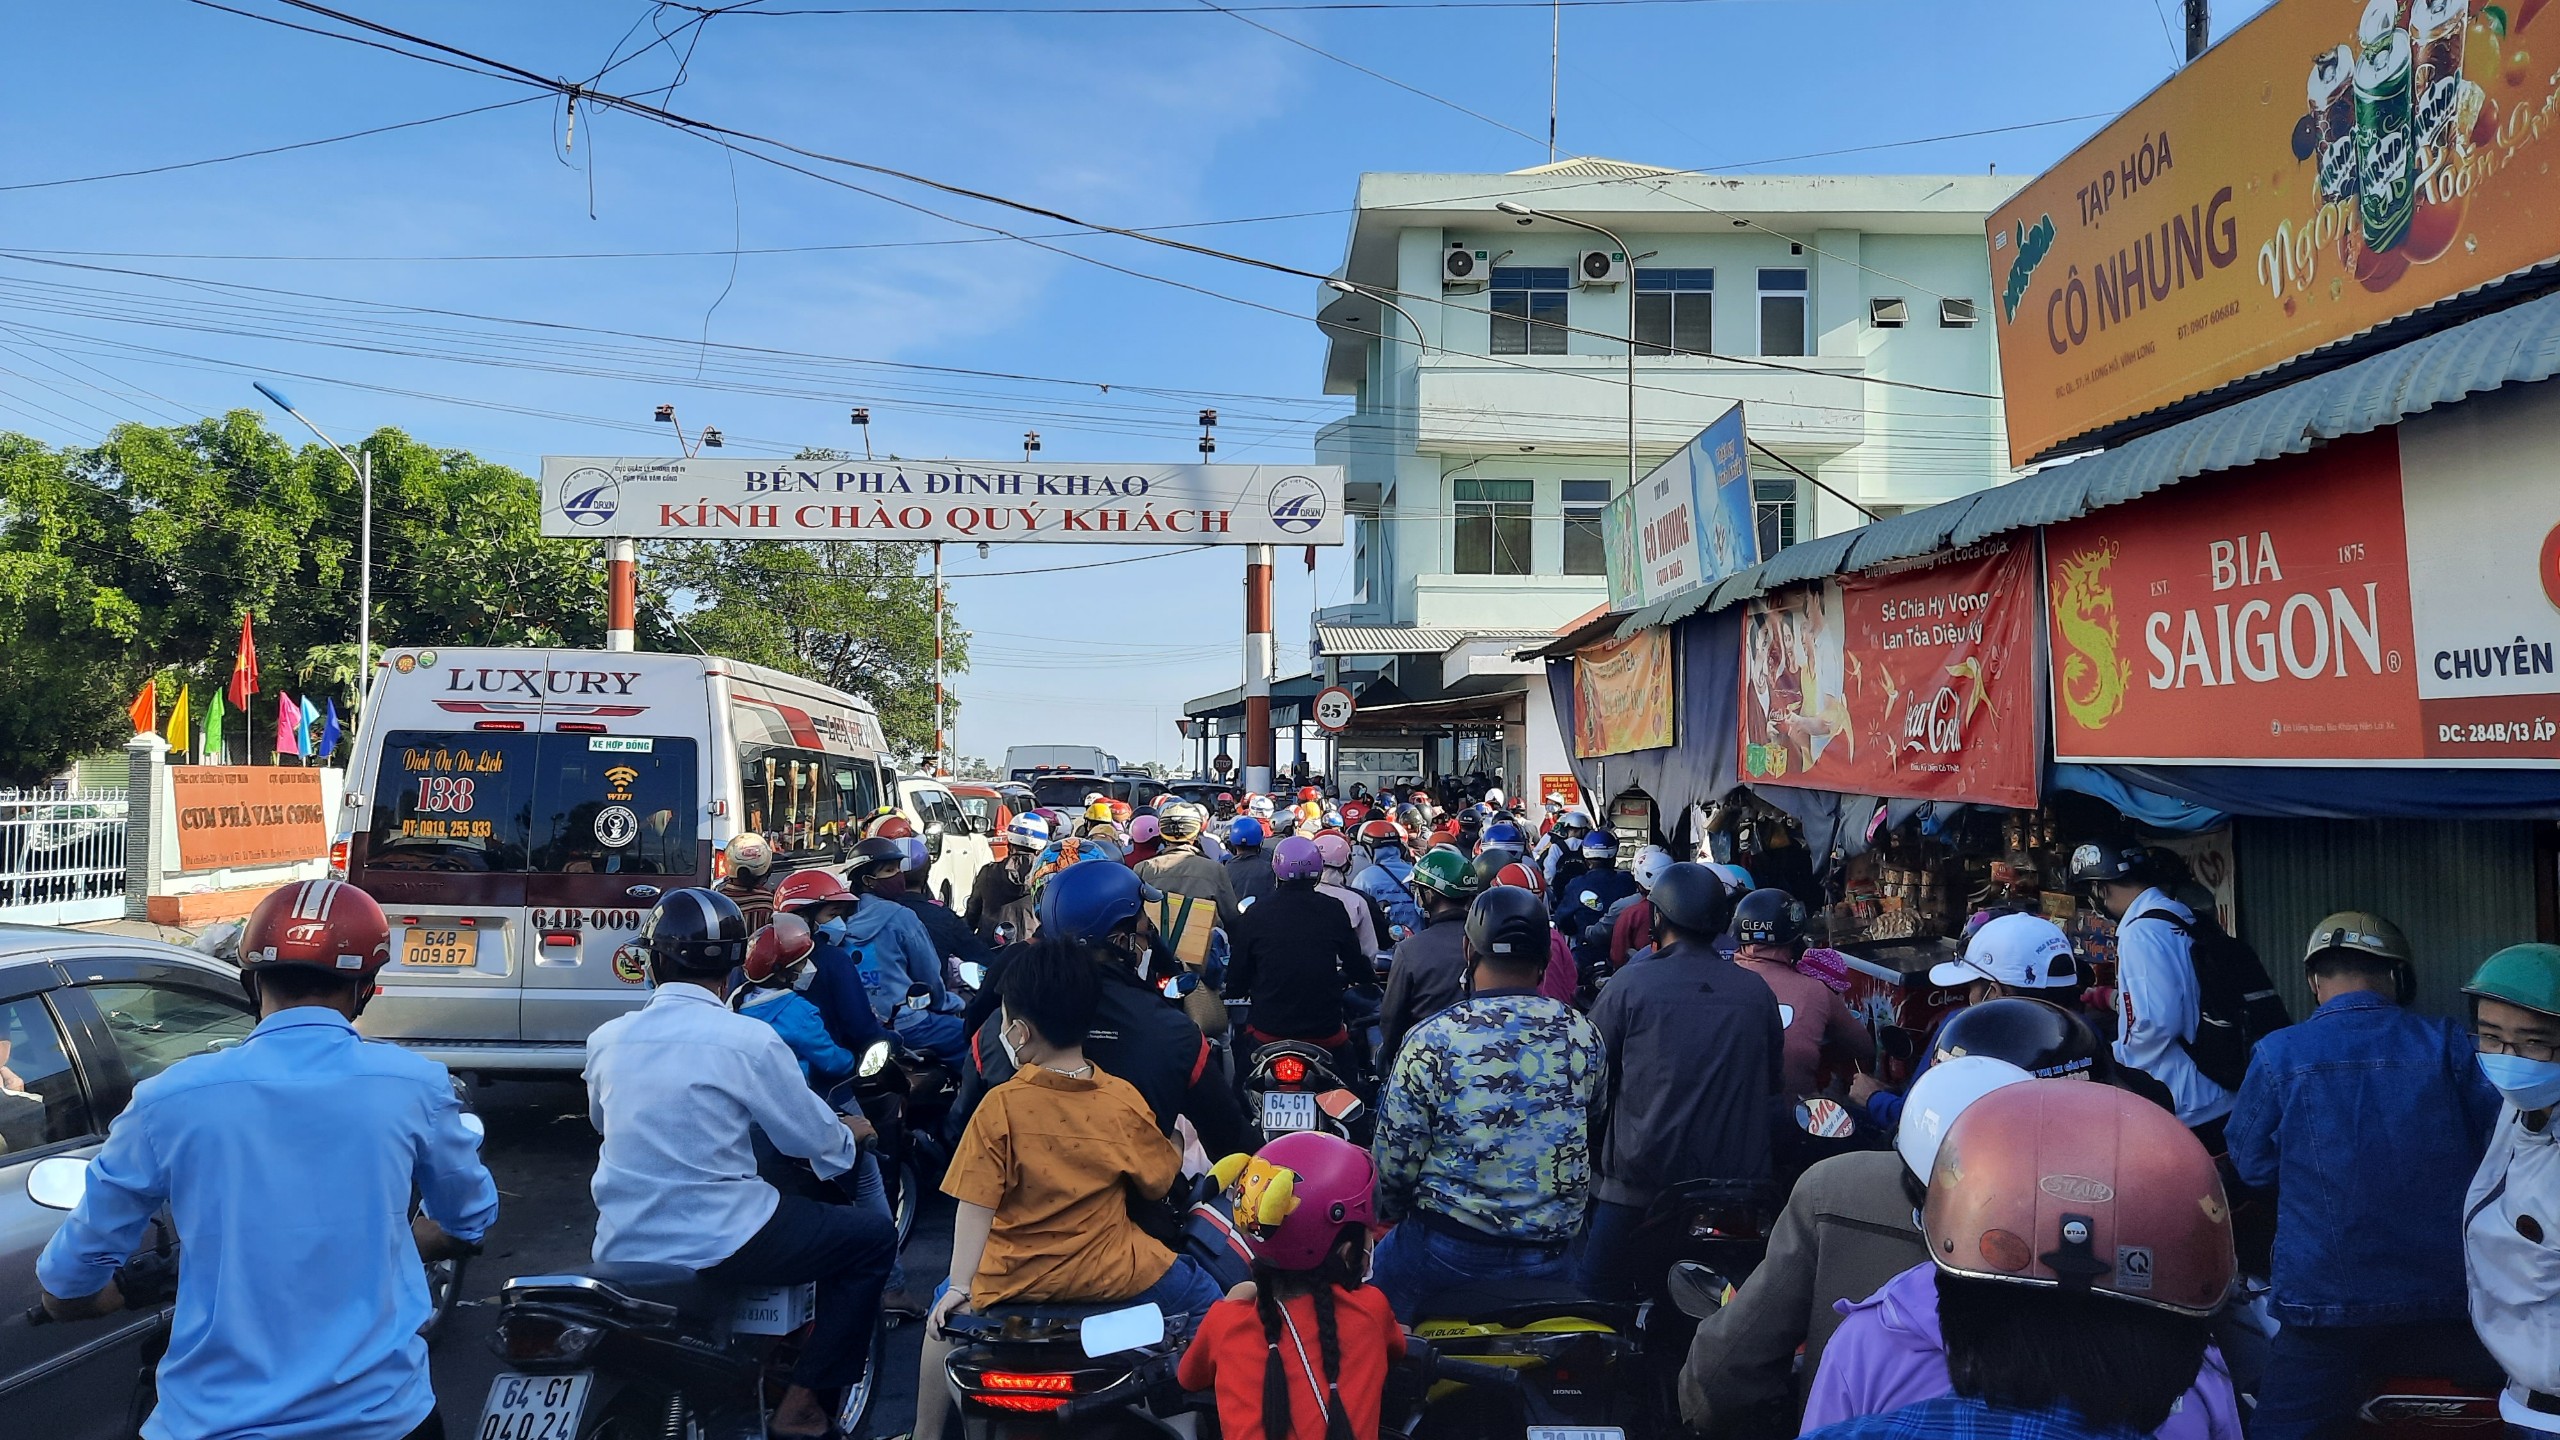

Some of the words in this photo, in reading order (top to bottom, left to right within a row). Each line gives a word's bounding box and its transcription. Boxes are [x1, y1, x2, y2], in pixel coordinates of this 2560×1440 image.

[2076, 169, 2116, 230] TẠP
[2120, 130, 2174, 201] HÓA
[2047, 264, 2089, 355] CÔ
[2094, 185, 2238, 333] NHUNG
[743, 465, 822, 494] BẾN
[834, 466, 912, 495] PHÀ
[923, 466, 1021, 496] ĐÌNH
[1034, 473, 1150, 497] KHAO
[658, 497, 782, 528] KÍNH
[794, 499, 933, 531] CHÀO
[946, 502, 1050, 535] QUÝ
[1060, 502, 1232, 534] KHÁCH
[1656, 502, 1690, 558] NHUNG
[2208, 531, 2283, 592] BIA
[2337, 542, 2366, 564] 1875
[2150, 579, 2171, 597] EST.
[1881, 598, 1897, 622] Sẻ
[1899, 598, 1925, 620] Chia
[1928, 595, 1945, 619] Hy
[1948, 591, 1989, 617] Vọng
[1882, 631, 1904, 650] Lan
[1906, 624, 1931, 647] Tỏa
[1932, 622, 1966, 649] Diệu
[2145, 581, 2383, 691] SAIGON
[2434, 634, 2554, 681] CHUYÊN
[445, 667, 642, 699] LUXURY
[2438, 724, 2466, 743] ĐC:
[2468, 721, 2530, 744] 284B/13
[2533, 715, 2557, 742] ẤP
[592, 740, 605, 749] XE
[606, 739, 624, 751] HỢP
[625, 739, 650, 751] ĐỒNG
[454, 749, 476, 772] Du
[1215, 760, 1232, 769] STOP
[413, 776, 475, 813] 138
[607, 793, 633, 801] WIFI
[450, 820, 471, 837] 255
[471, 820, 492, 838] 933
[425, 931, 457, 947] 64B
[410, 948, 468, 964] 009.87
[1271, 1094, 1307, 1111] 64-G1
[1265, 1111, 1311, 1128] 007.01
[2046, 1177, 2108, 1200] STAR
[1434, 1327, 1470, 1337] BLADE
[501, 1377, 575, 1410] 64-G1
